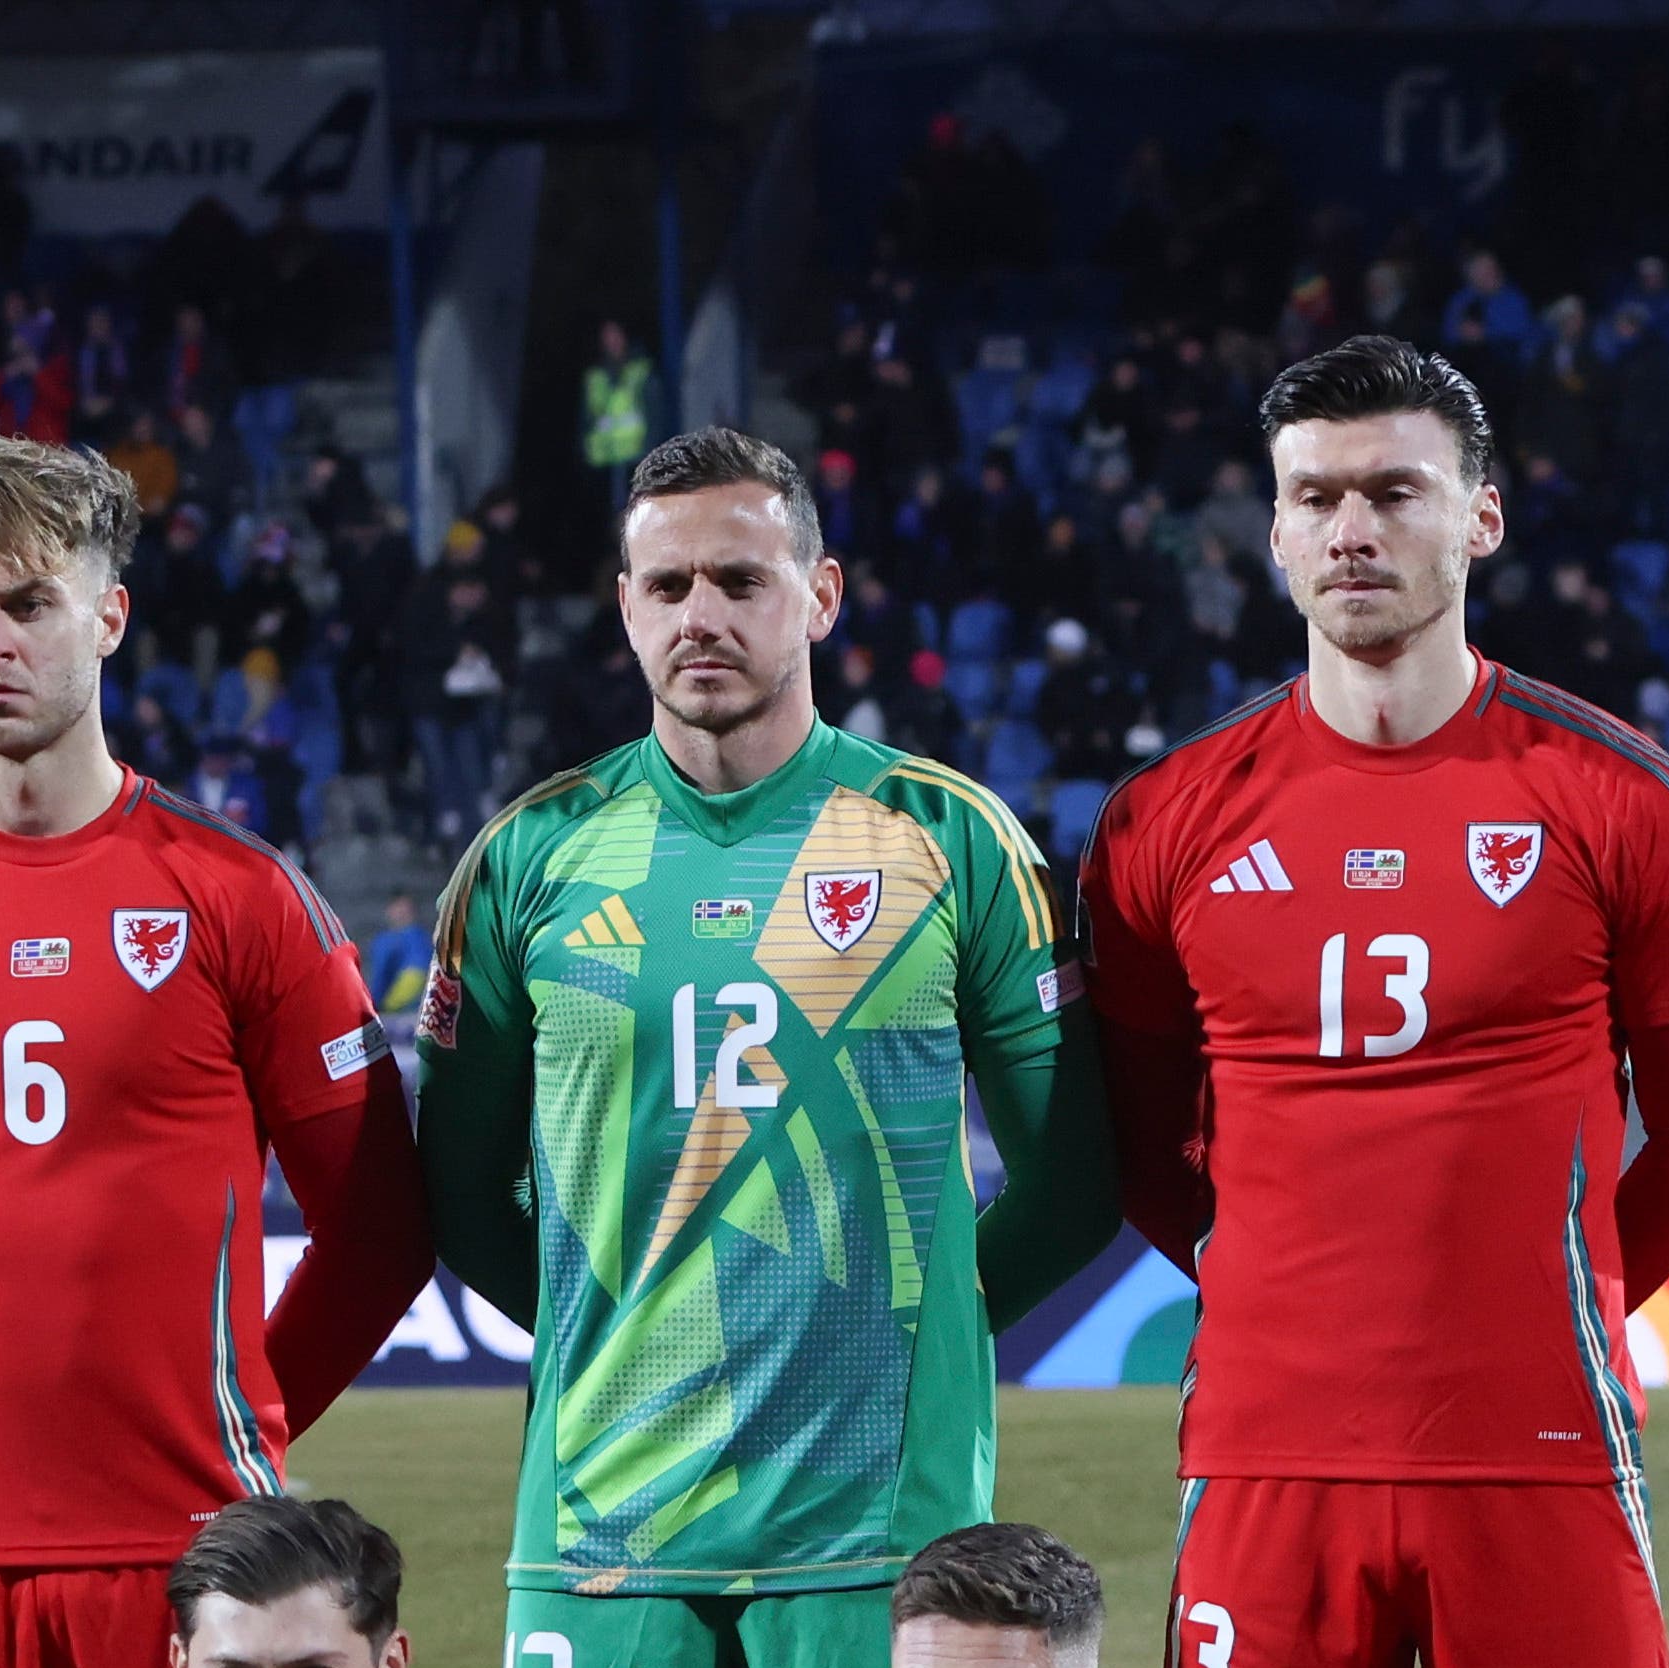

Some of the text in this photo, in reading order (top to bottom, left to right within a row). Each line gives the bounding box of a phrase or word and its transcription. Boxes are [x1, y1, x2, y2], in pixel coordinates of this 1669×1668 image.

[673, 982, 779, 1108] 12
[1319, 933, 1430, 1058] 13
[3, 1020, 67, 1146] 6
